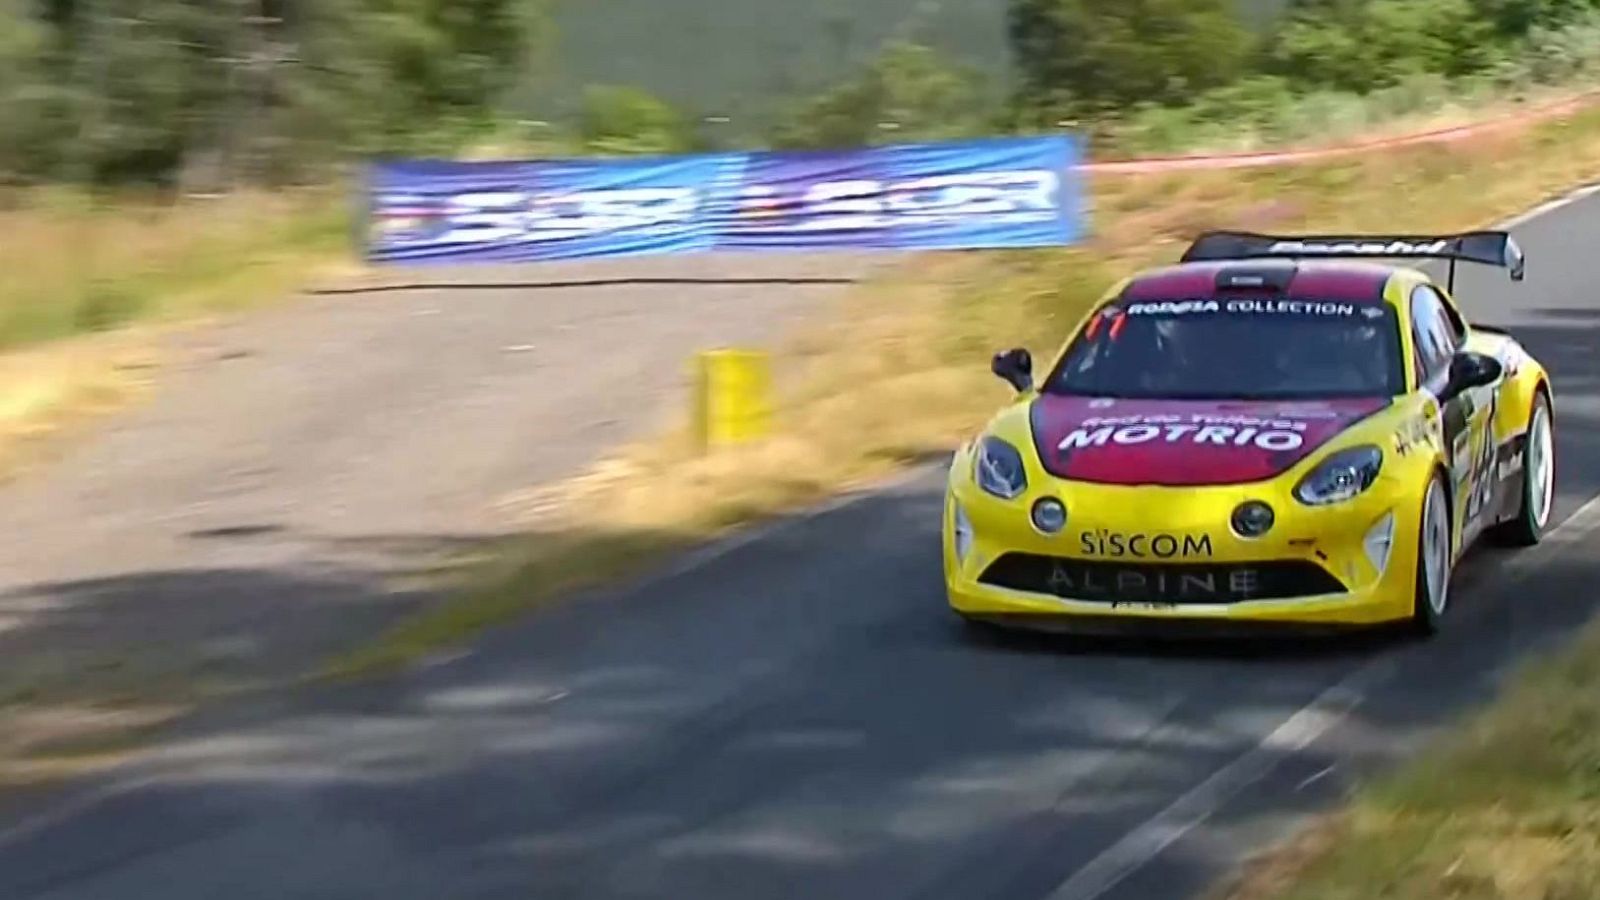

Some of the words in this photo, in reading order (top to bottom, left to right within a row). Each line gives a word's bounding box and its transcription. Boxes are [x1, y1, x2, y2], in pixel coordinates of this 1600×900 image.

[1226, 300, 1354, 315] COLLECTION
[1085, 312, 1126, 342] 11
[1058, 424, 1304, 452] MOTRIO
[1047, 565, 1259, 594] ALPINE
